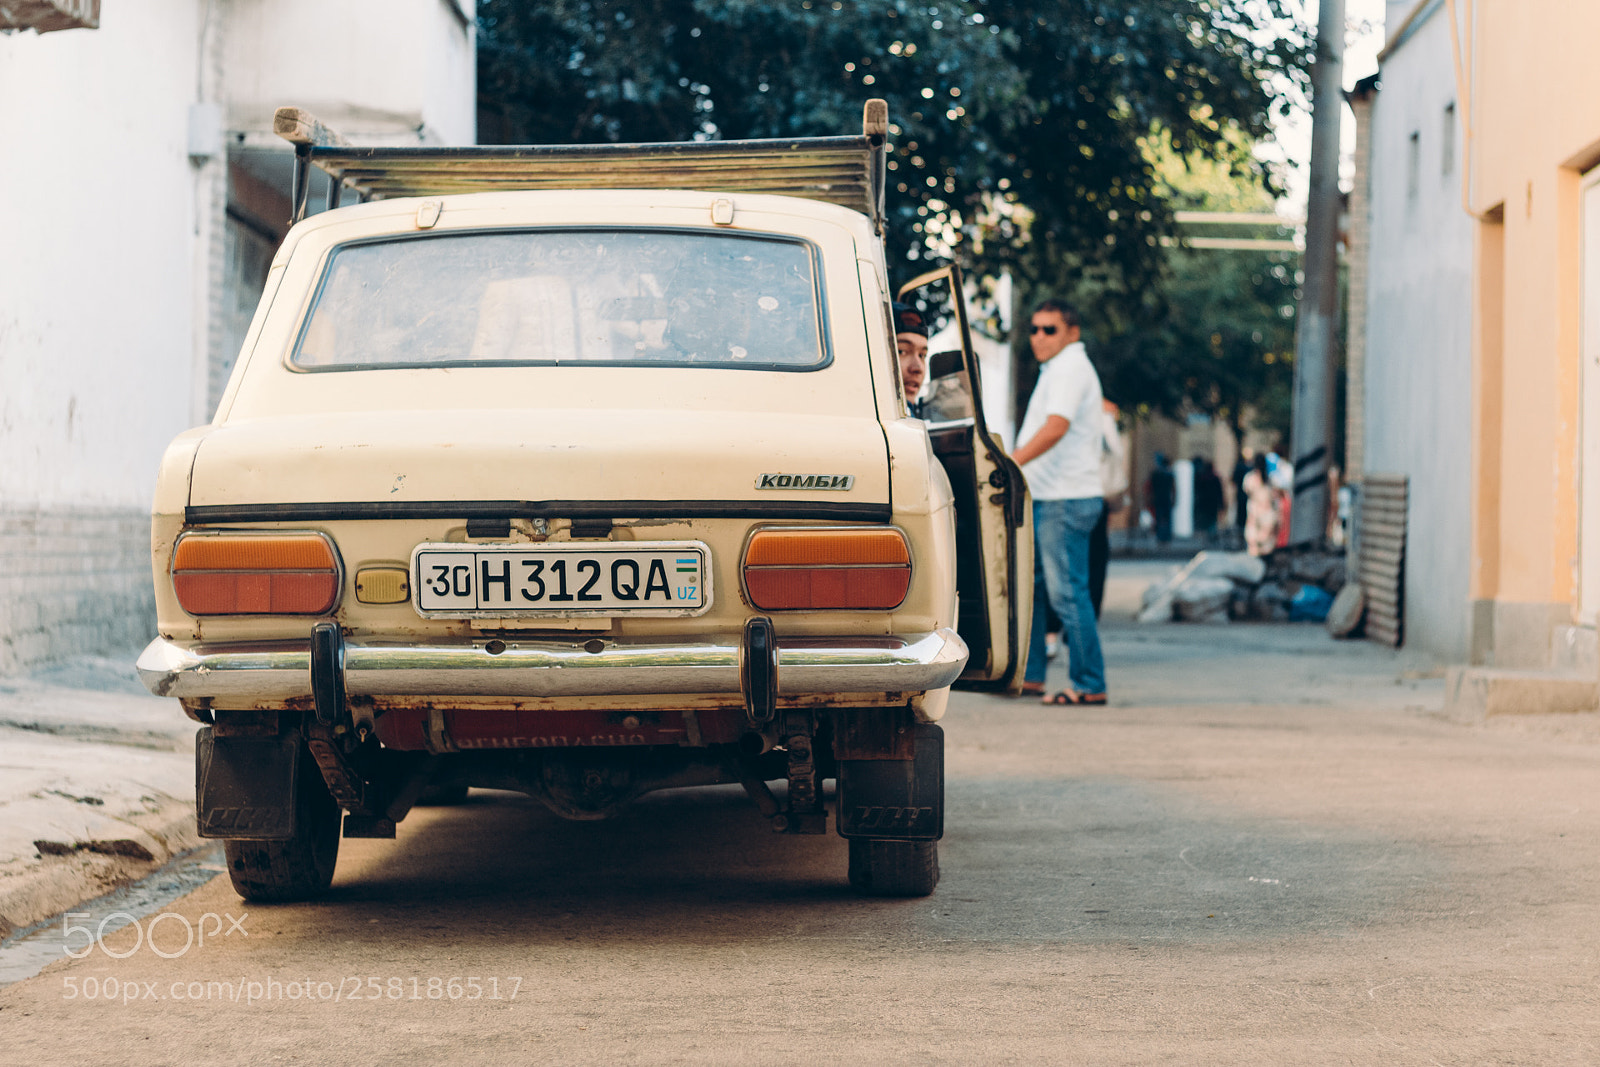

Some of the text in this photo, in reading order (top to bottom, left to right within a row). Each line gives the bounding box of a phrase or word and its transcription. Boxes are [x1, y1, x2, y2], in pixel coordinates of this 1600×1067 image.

[760, 474, 849, 488] КОМБИ
[432, 565, 471, 597] 30
[677, 586, 697, 600] UZ
